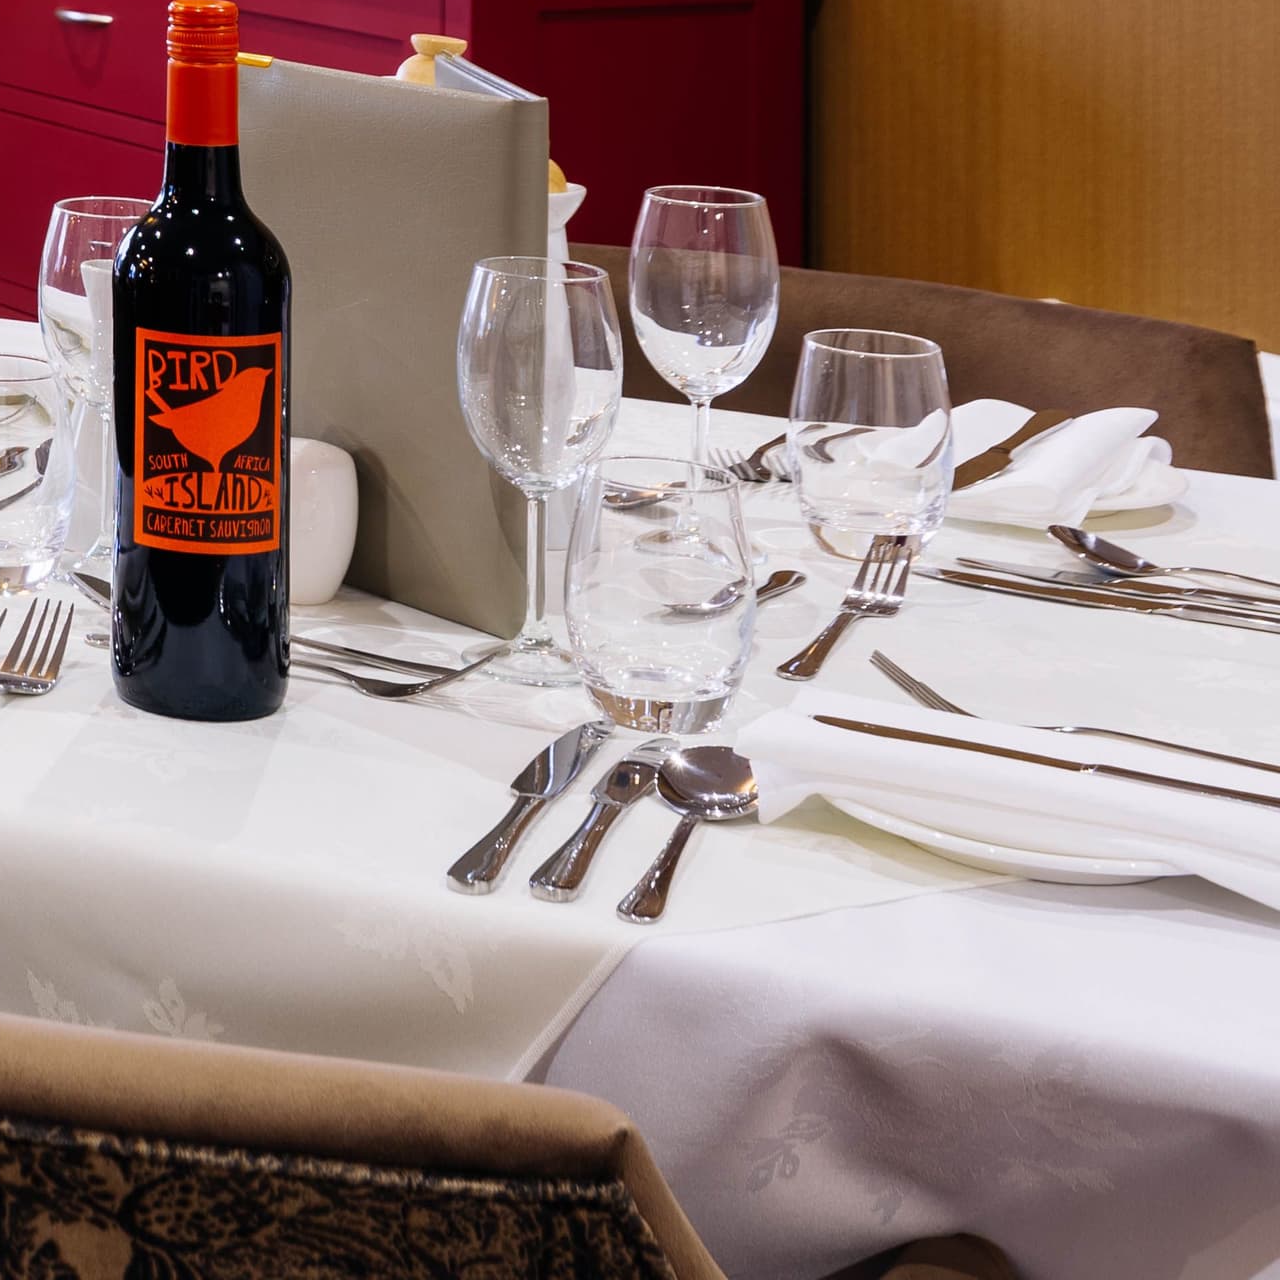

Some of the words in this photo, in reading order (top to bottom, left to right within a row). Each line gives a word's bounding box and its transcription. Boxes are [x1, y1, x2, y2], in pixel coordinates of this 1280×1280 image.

[148, 349, 238, 391] BIRD
[148, 453, 189, 471] SOUTH
[233, 454, 271, 473] AFRICA
[164, 472, 263, 512] ISLAND
[146, 512, 206, 537] CABERNET
